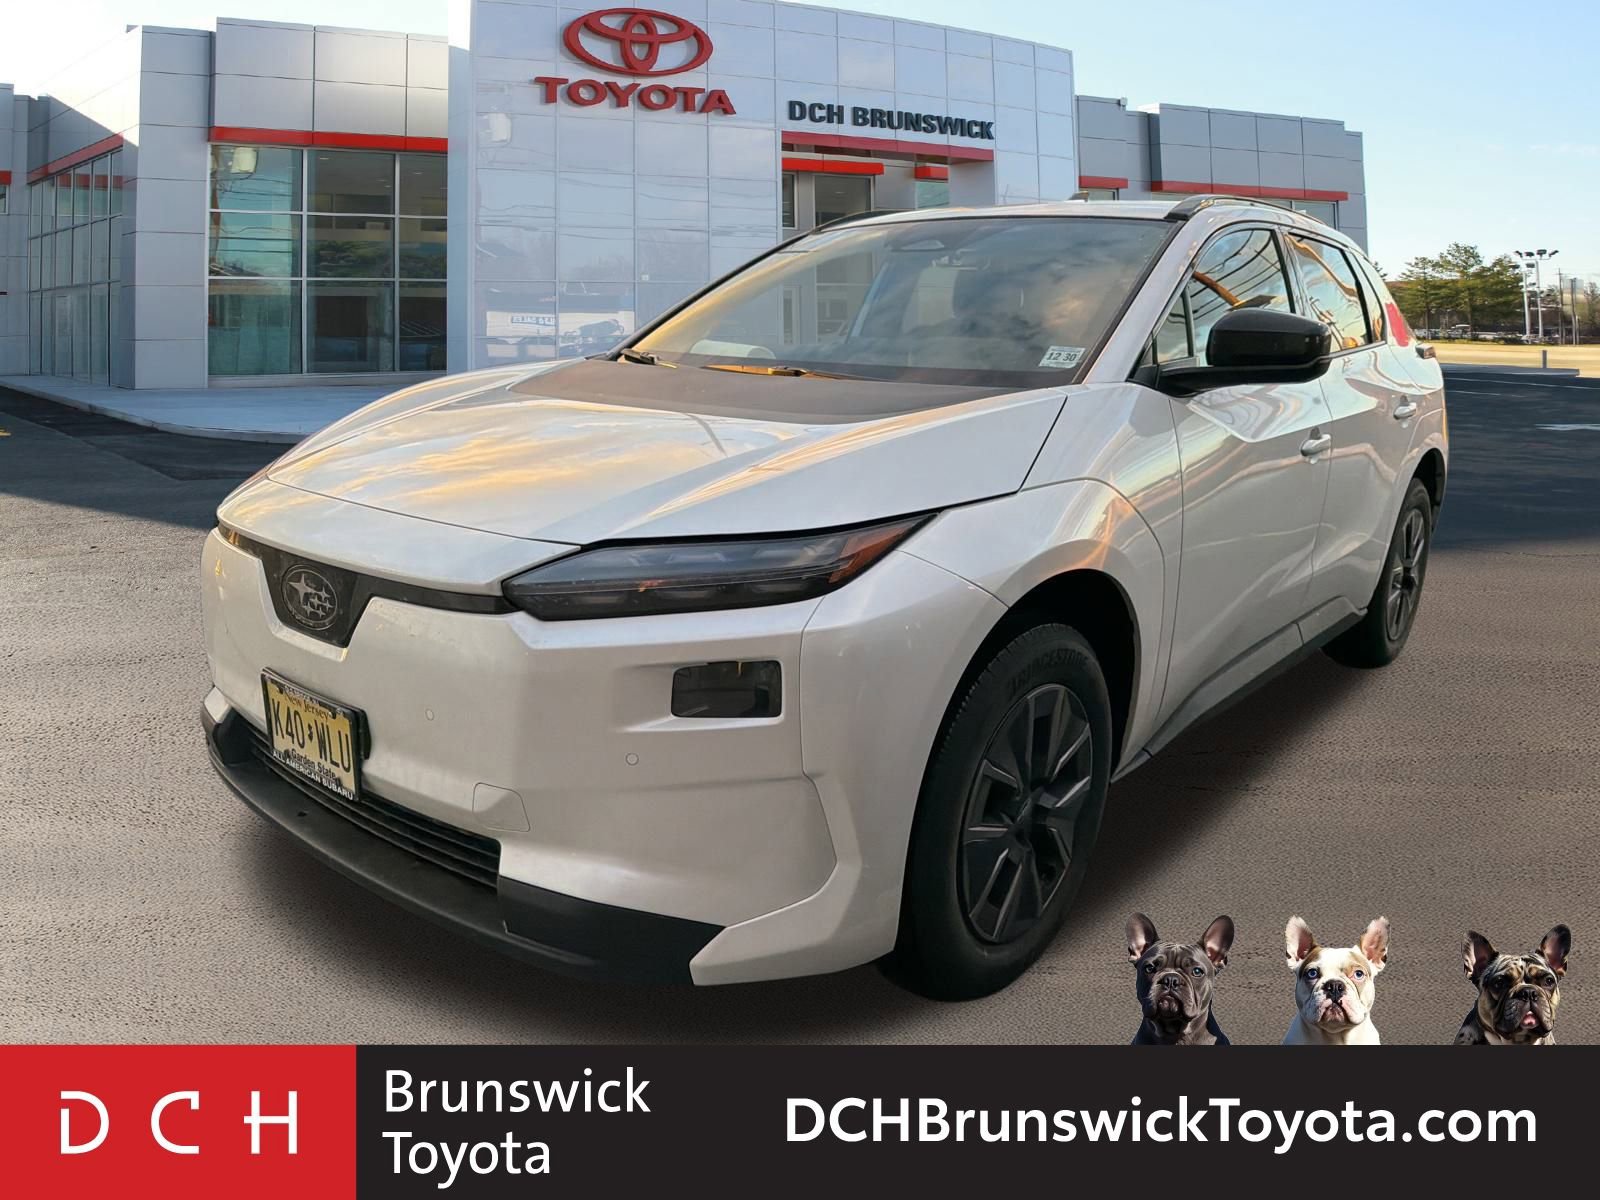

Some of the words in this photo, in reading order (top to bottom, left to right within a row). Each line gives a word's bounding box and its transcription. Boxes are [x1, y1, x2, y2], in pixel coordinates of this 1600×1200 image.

[534, 75, 737, 116] TOYOTA
[787, 100, 845, 125] DCH
[852, 105, 995, 140] BRUNSWICK
[271, 698, 305, 749] K40
[313, 719, 351, 773] WLU
[272, 750, 286, 763] ALL
[286, 758, 321, 784] AMERICAN
[322, 778, 354, 800] SUBARU
[291, 748, 316, 769] Garden
